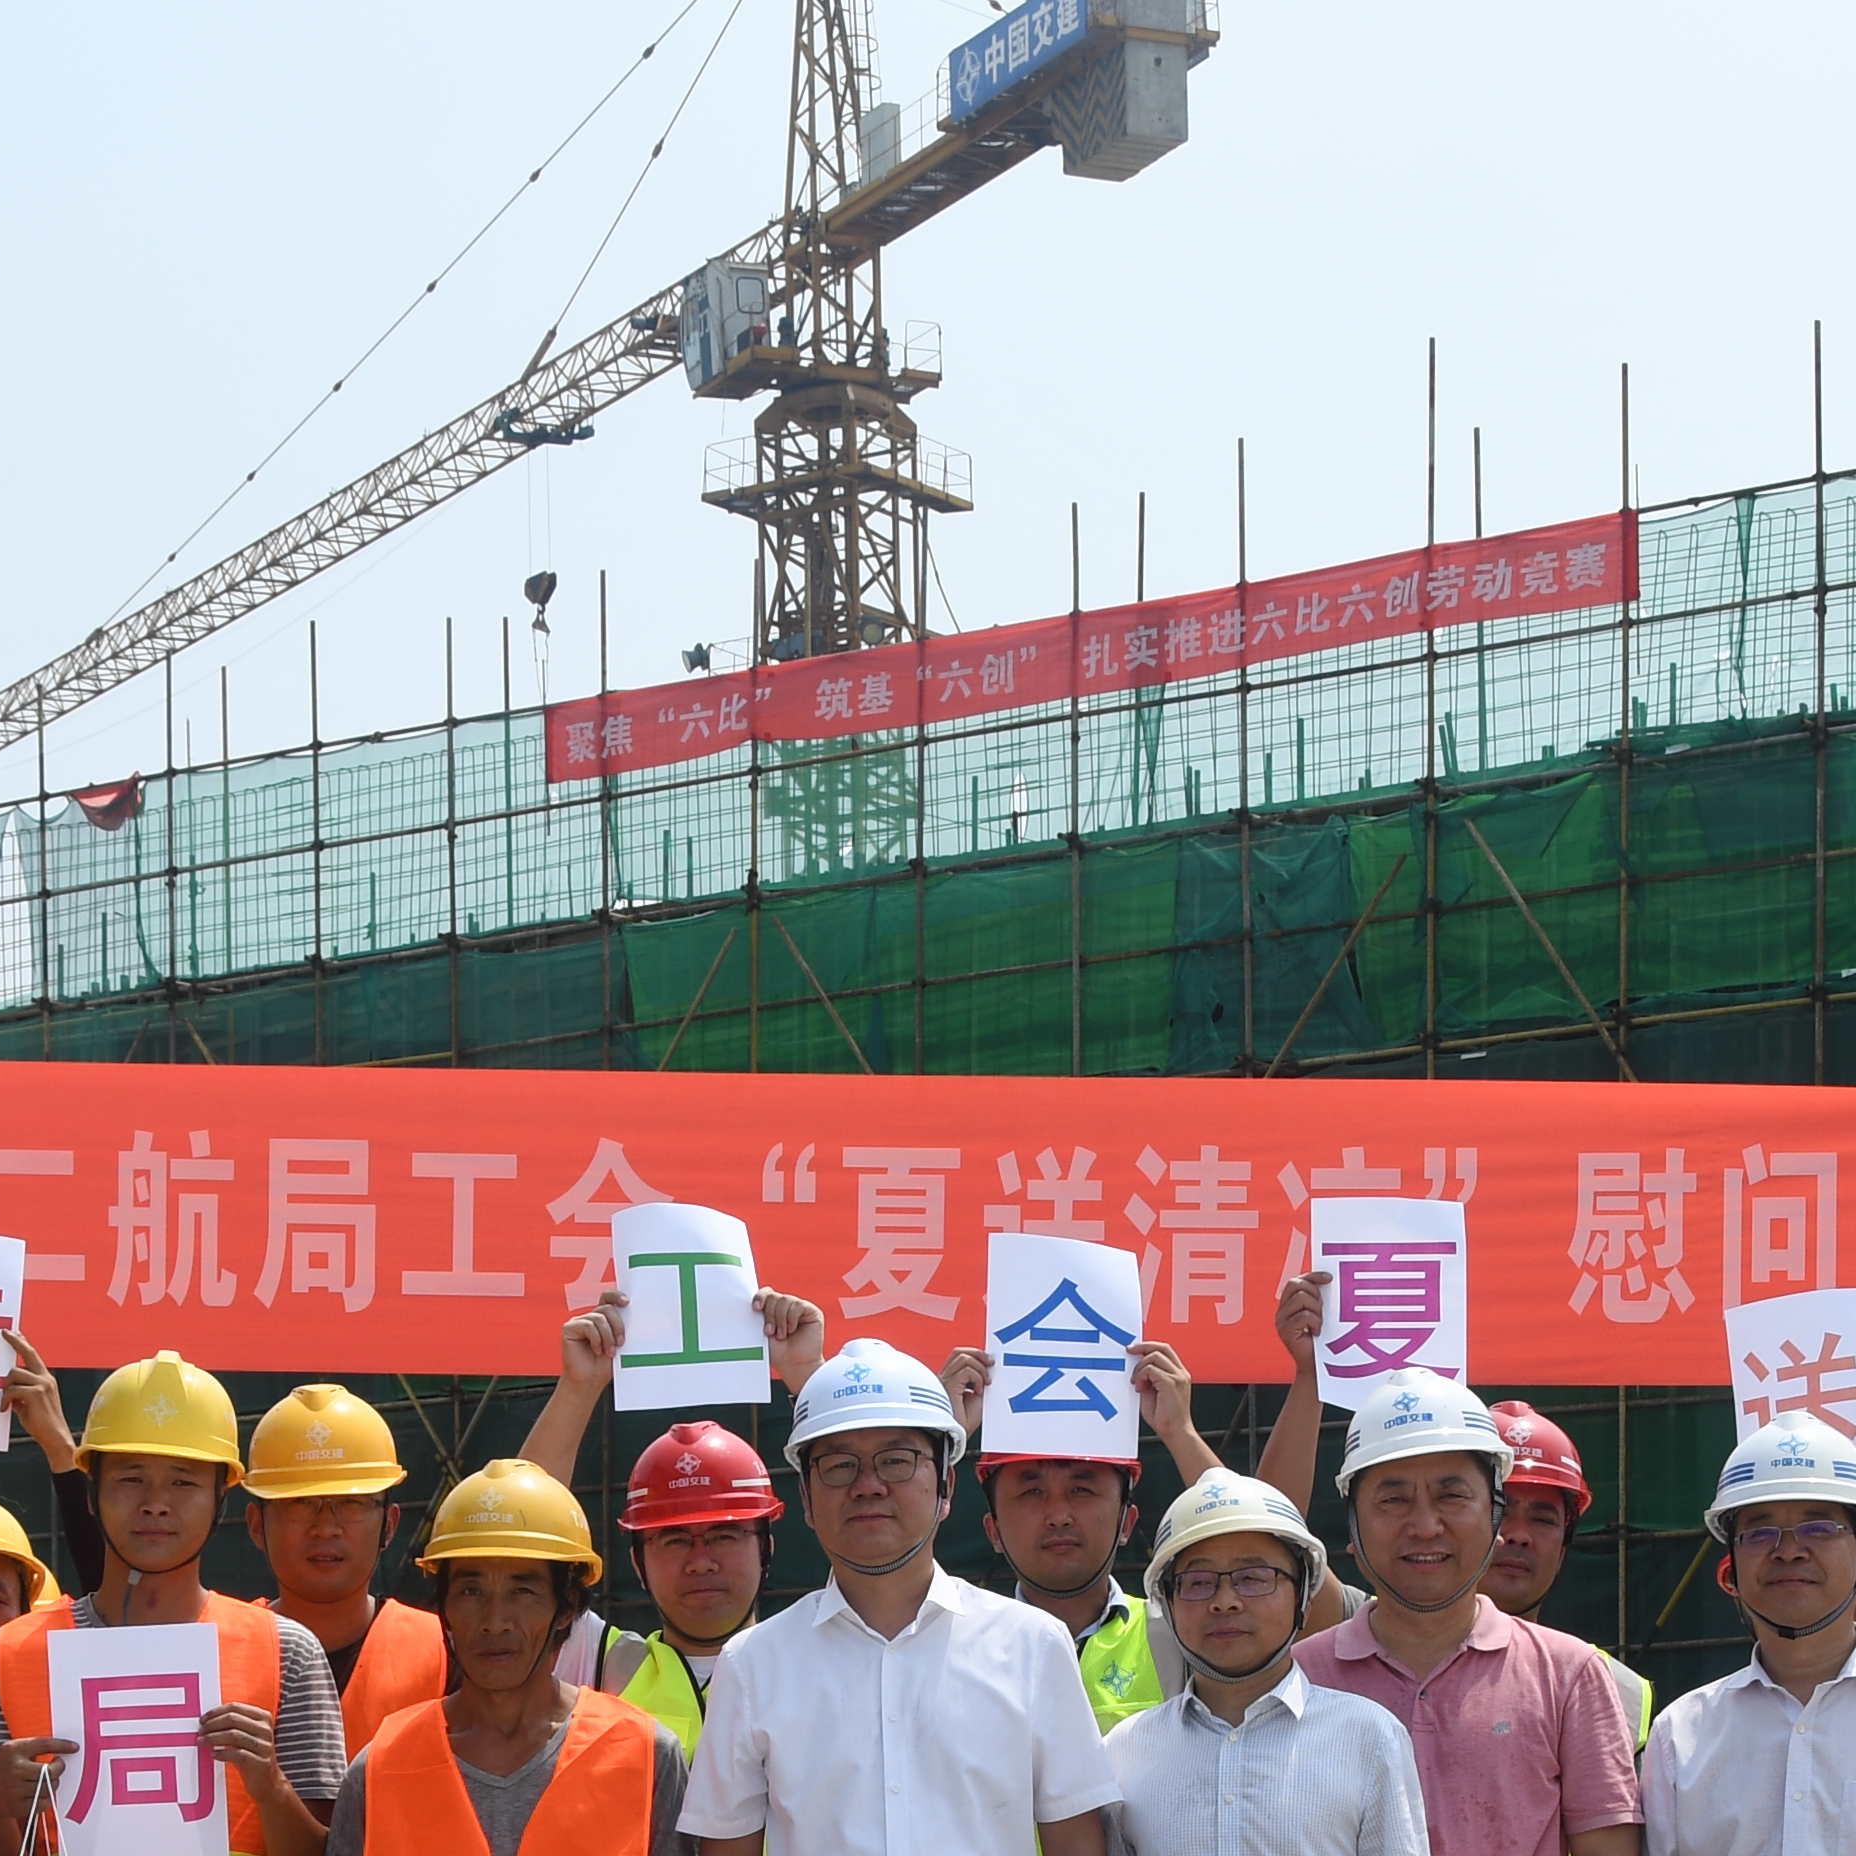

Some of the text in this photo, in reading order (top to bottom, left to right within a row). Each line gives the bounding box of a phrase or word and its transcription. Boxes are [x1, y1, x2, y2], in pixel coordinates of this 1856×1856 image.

[984, 0, 1080, 85] 中国交建
[566, 542, 1607, 763] 聚焦 “六比” 筑基 “六创” 扎实推进六比六创劳动竞赛
[621, 1250, 764, 1367] 工
[1320, 1242, 1458, 1380] 夏
[994, 1276, 1136, 1424] 会
[832, 1384, 885, 1400] 中国交建
[1383, 1413, 1434, 1431] 中国交建
[295, 1449, 344, 1461] 中国交建
[1770, 1457, 1816, 1470] 中国交建
[668, 1476, 711, 1490] 中国交建
[1194, 1497, 1241, 1516] 中国交建
[464, 1512, 516, 1526] 中国交建
[64, 1672, 216, 1825] 局
